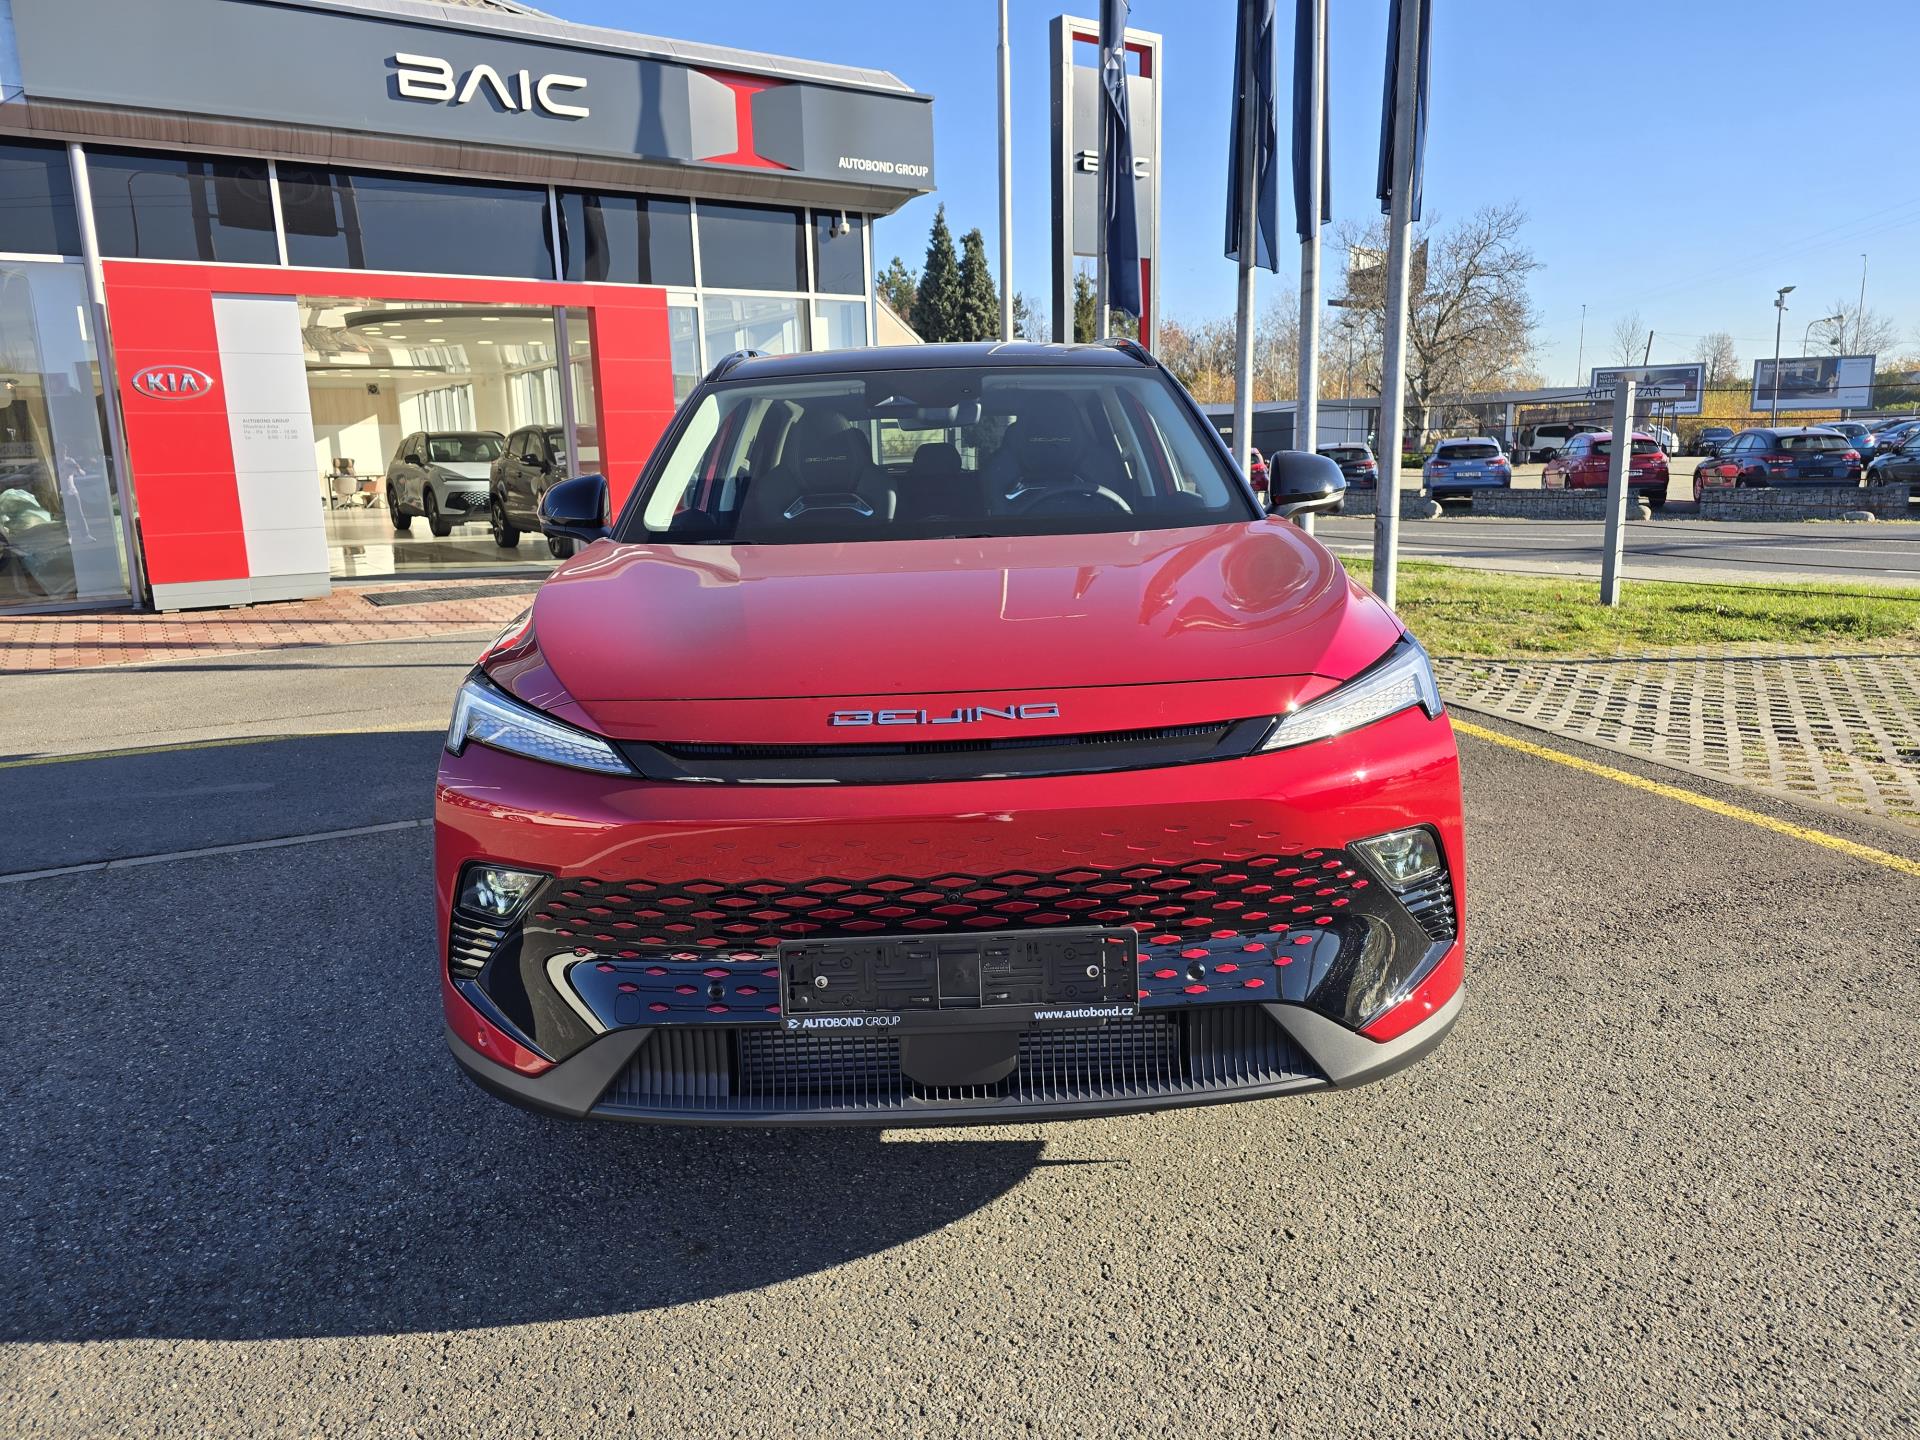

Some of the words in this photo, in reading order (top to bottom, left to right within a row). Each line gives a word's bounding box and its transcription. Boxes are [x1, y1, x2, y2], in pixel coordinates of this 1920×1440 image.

[396, 52, 589, 117] BAIC
[838, 157, 894, 173] AUTOBOND
[895, 163, 929, 177] GROUP
[1083, 149, 1150, 177] BC
[146, 373, 200, 392] KIA
[1585, 387, 1662, 400] AUTZAR
[833, 703, 1059, 726] BEIJING
[1034, 1005, 1134, 1020] www.autobond.cz
[802, 1018, 863, 1029] AUTOBOND
[865, 1016, 900, 1027] GROUP
